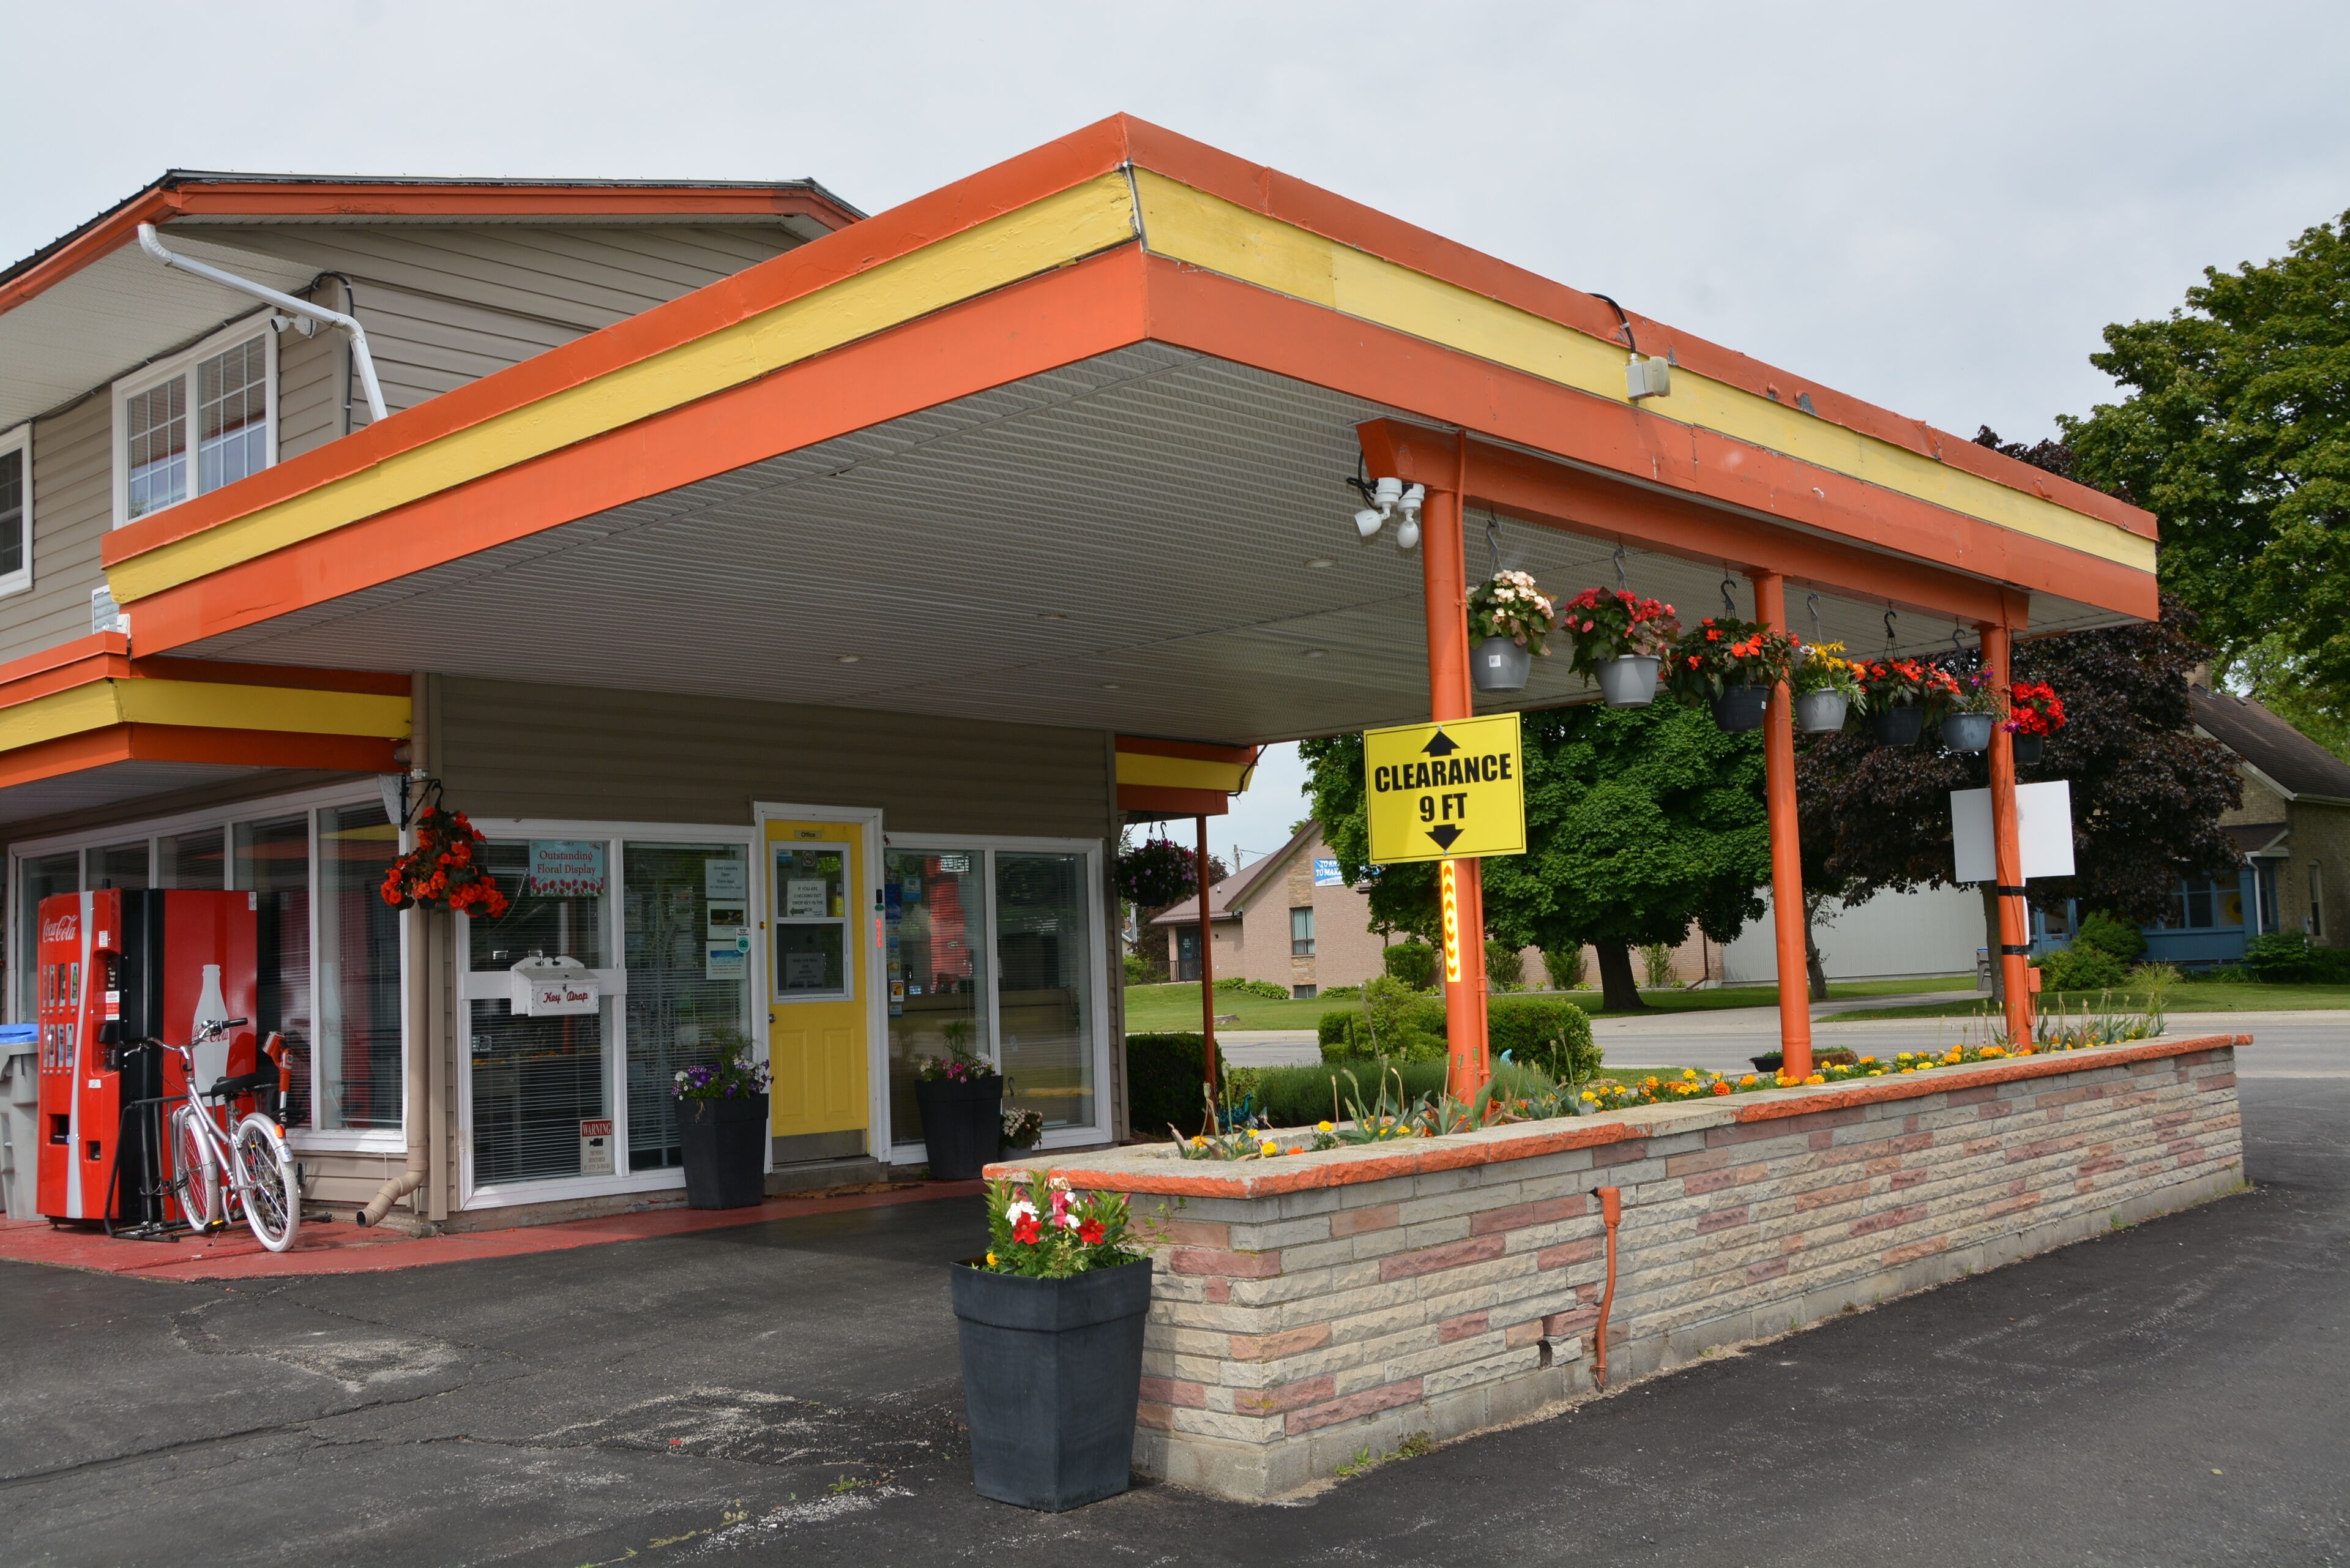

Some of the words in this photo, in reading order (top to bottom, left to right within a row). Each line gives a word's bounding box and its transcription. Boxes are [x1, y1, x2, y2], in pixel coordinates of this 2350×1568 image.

[1375, 753, 1512, 793] CLEARANCE
[1419, 795, 1435, 823] 9
[1441, 792, 1468, 821] FT
[539, 850, 593, 862] Outstanding
[537, 864, 562, 873] Floral
[565, 864, 596, 876] Display
[543, 991, 561, 1004] Key
[566, 990, 589, 1002] Drop
[583, 1122, 611, 1136] WARNING
